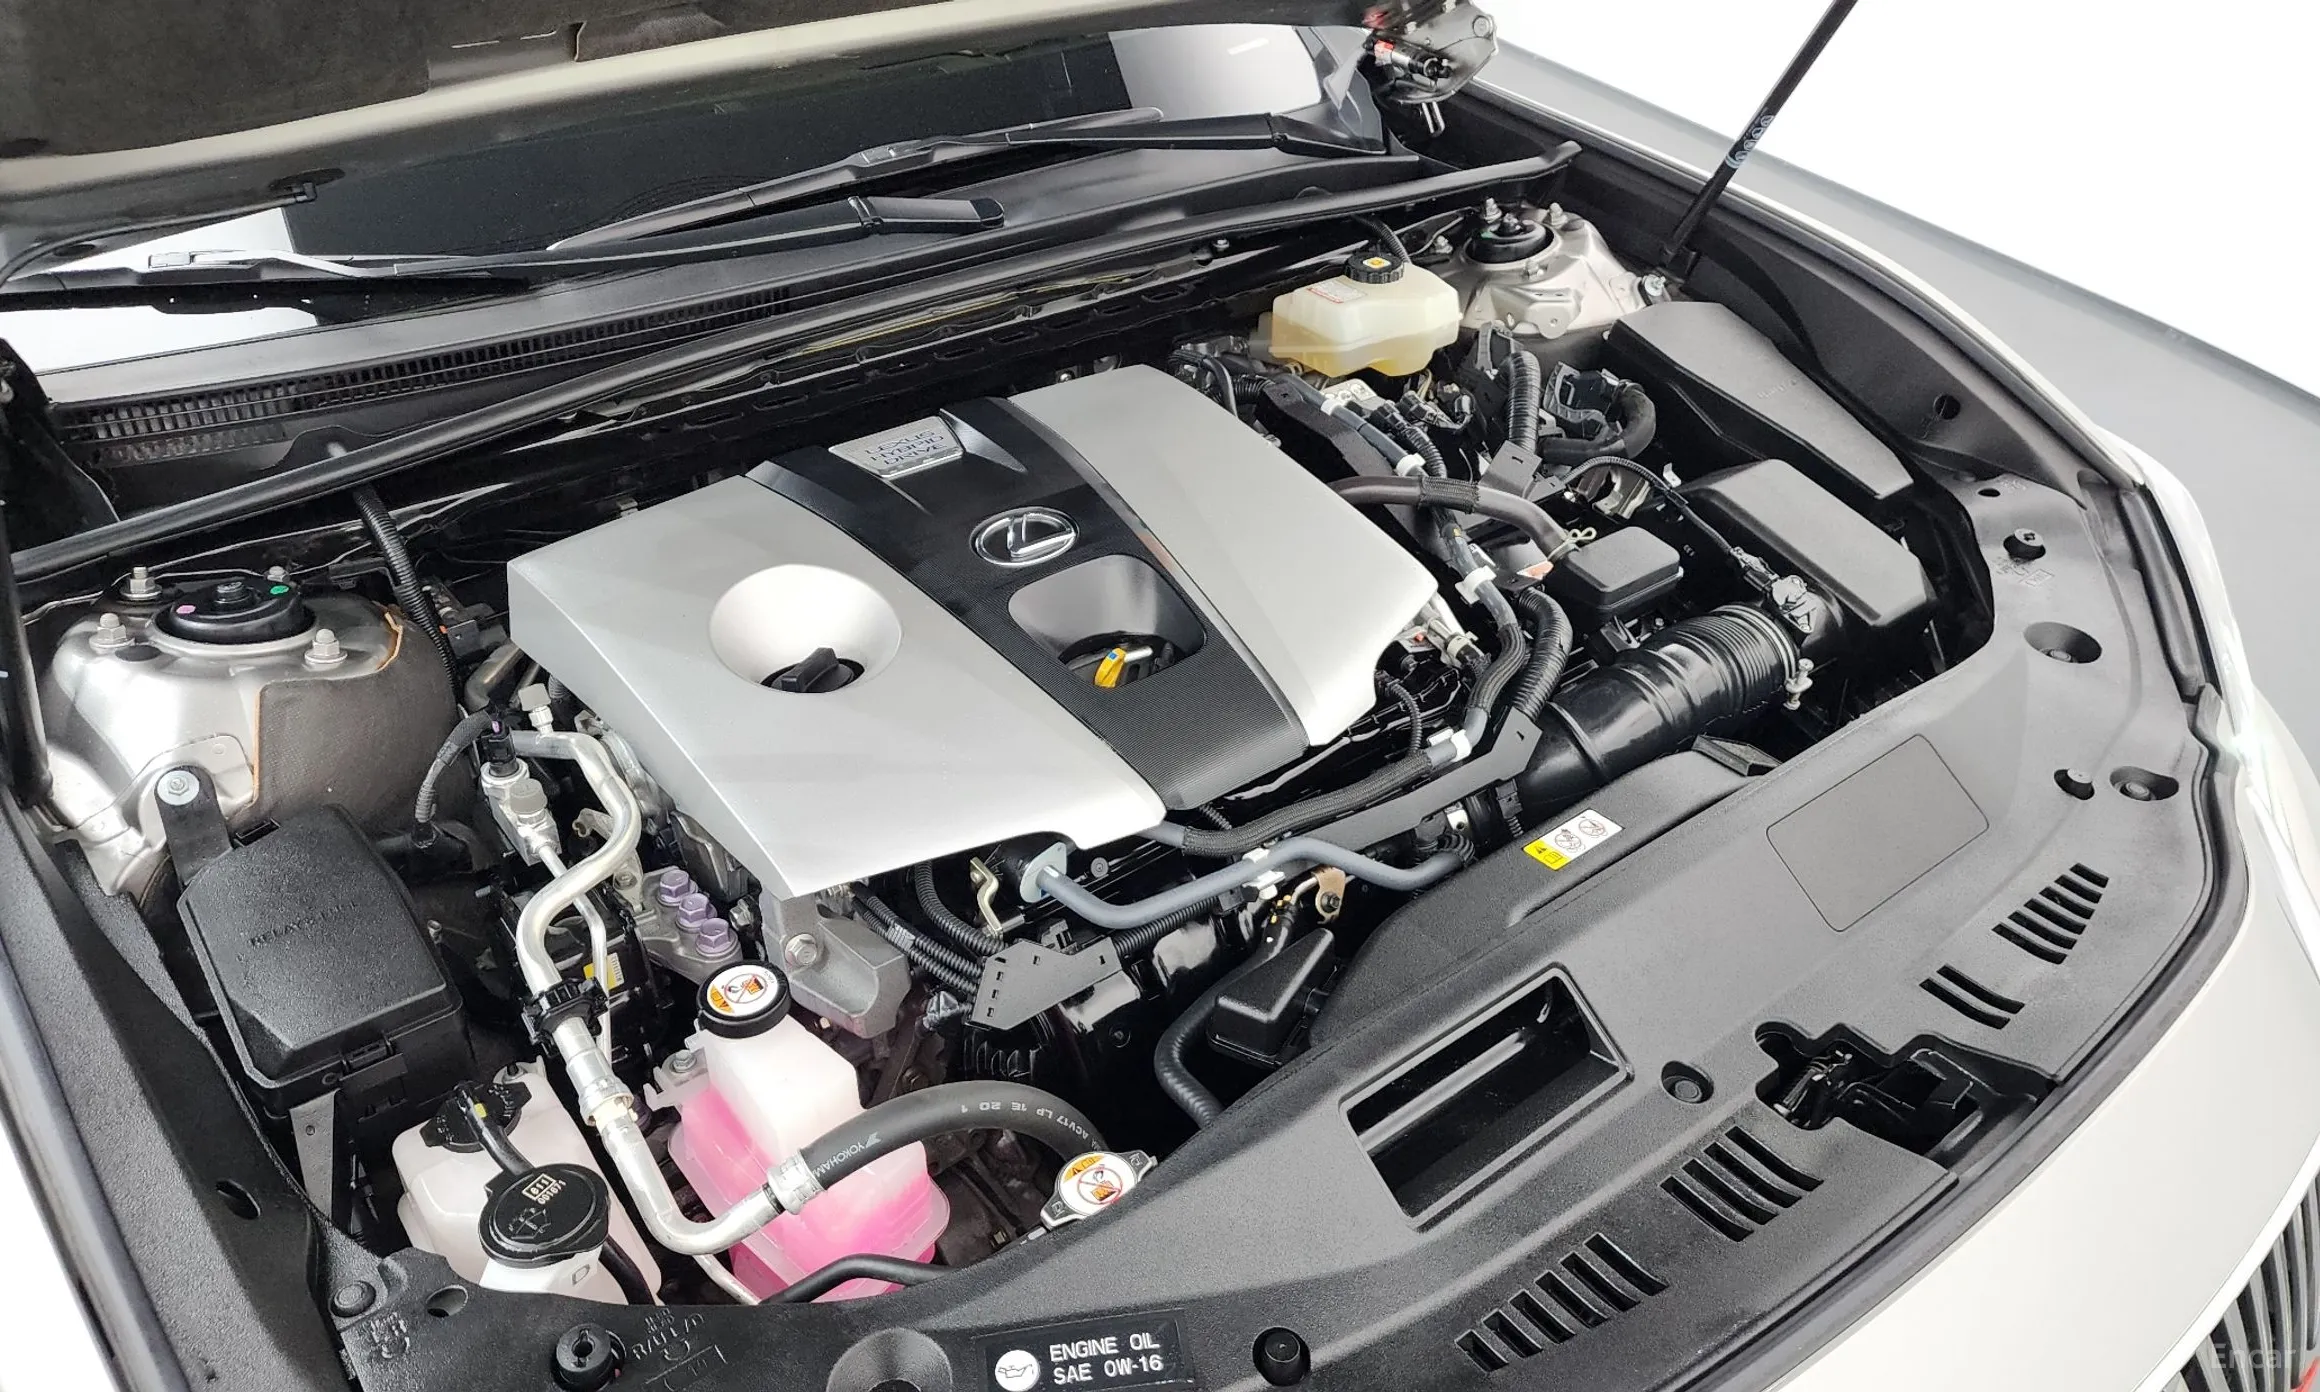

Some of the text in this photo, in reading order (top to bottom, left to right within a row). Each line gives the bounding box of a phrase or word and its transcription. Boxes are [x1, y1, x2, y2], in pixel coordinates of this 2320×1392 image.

[1050, 1332, 1160, 1363] ENGINE OIL
[1053, 1354, 1164, 1385] SAE 0W-16
